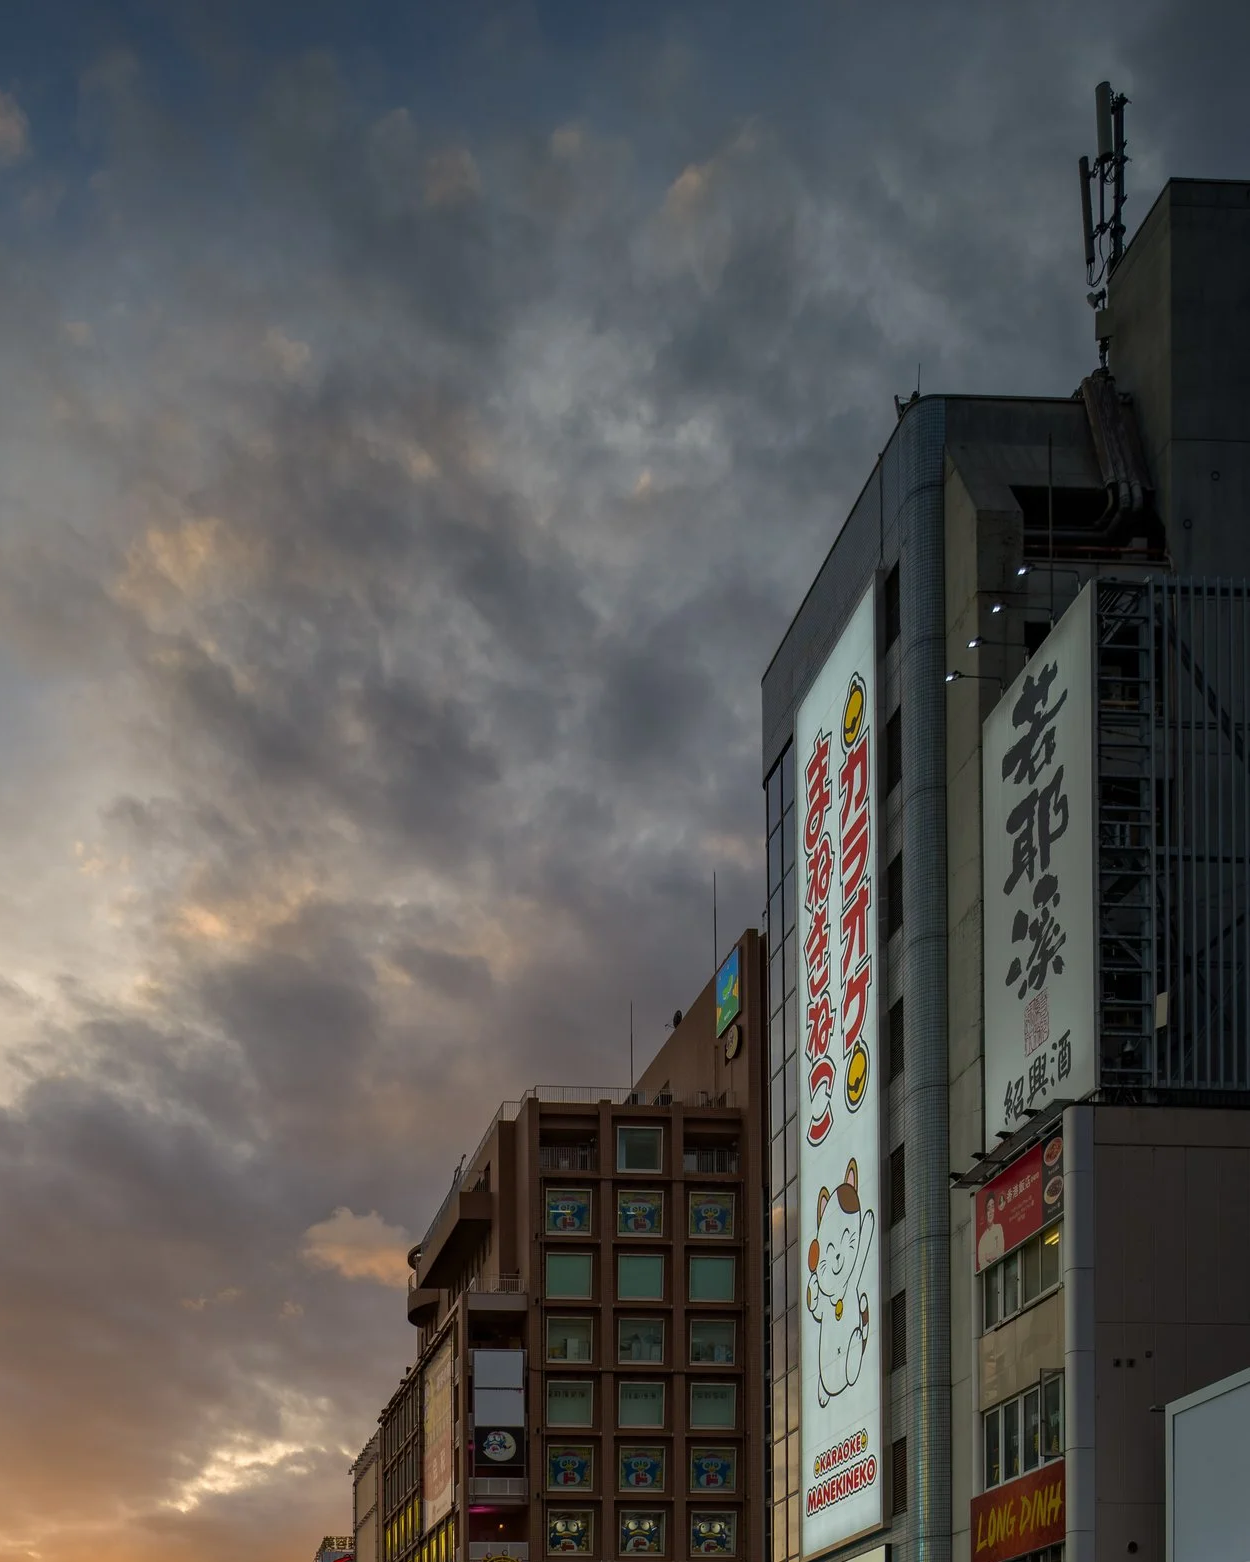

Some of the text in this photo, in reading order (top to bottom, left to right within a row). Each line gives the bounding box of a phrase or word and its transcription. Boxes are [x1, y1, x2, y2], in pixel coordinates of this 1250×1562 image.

[841, 727, 872, 1056] カラオケ
[805, 730, 836, 1147] まねきねこ
[1004, 1028, 1071, 1126] 紹興酒
[807, 1457, 876, 1514] MANEKINEKO
[819, 1433, 861, 1473] KARAOKE
[975, 1481, 1063, 1555] LONG DINH
